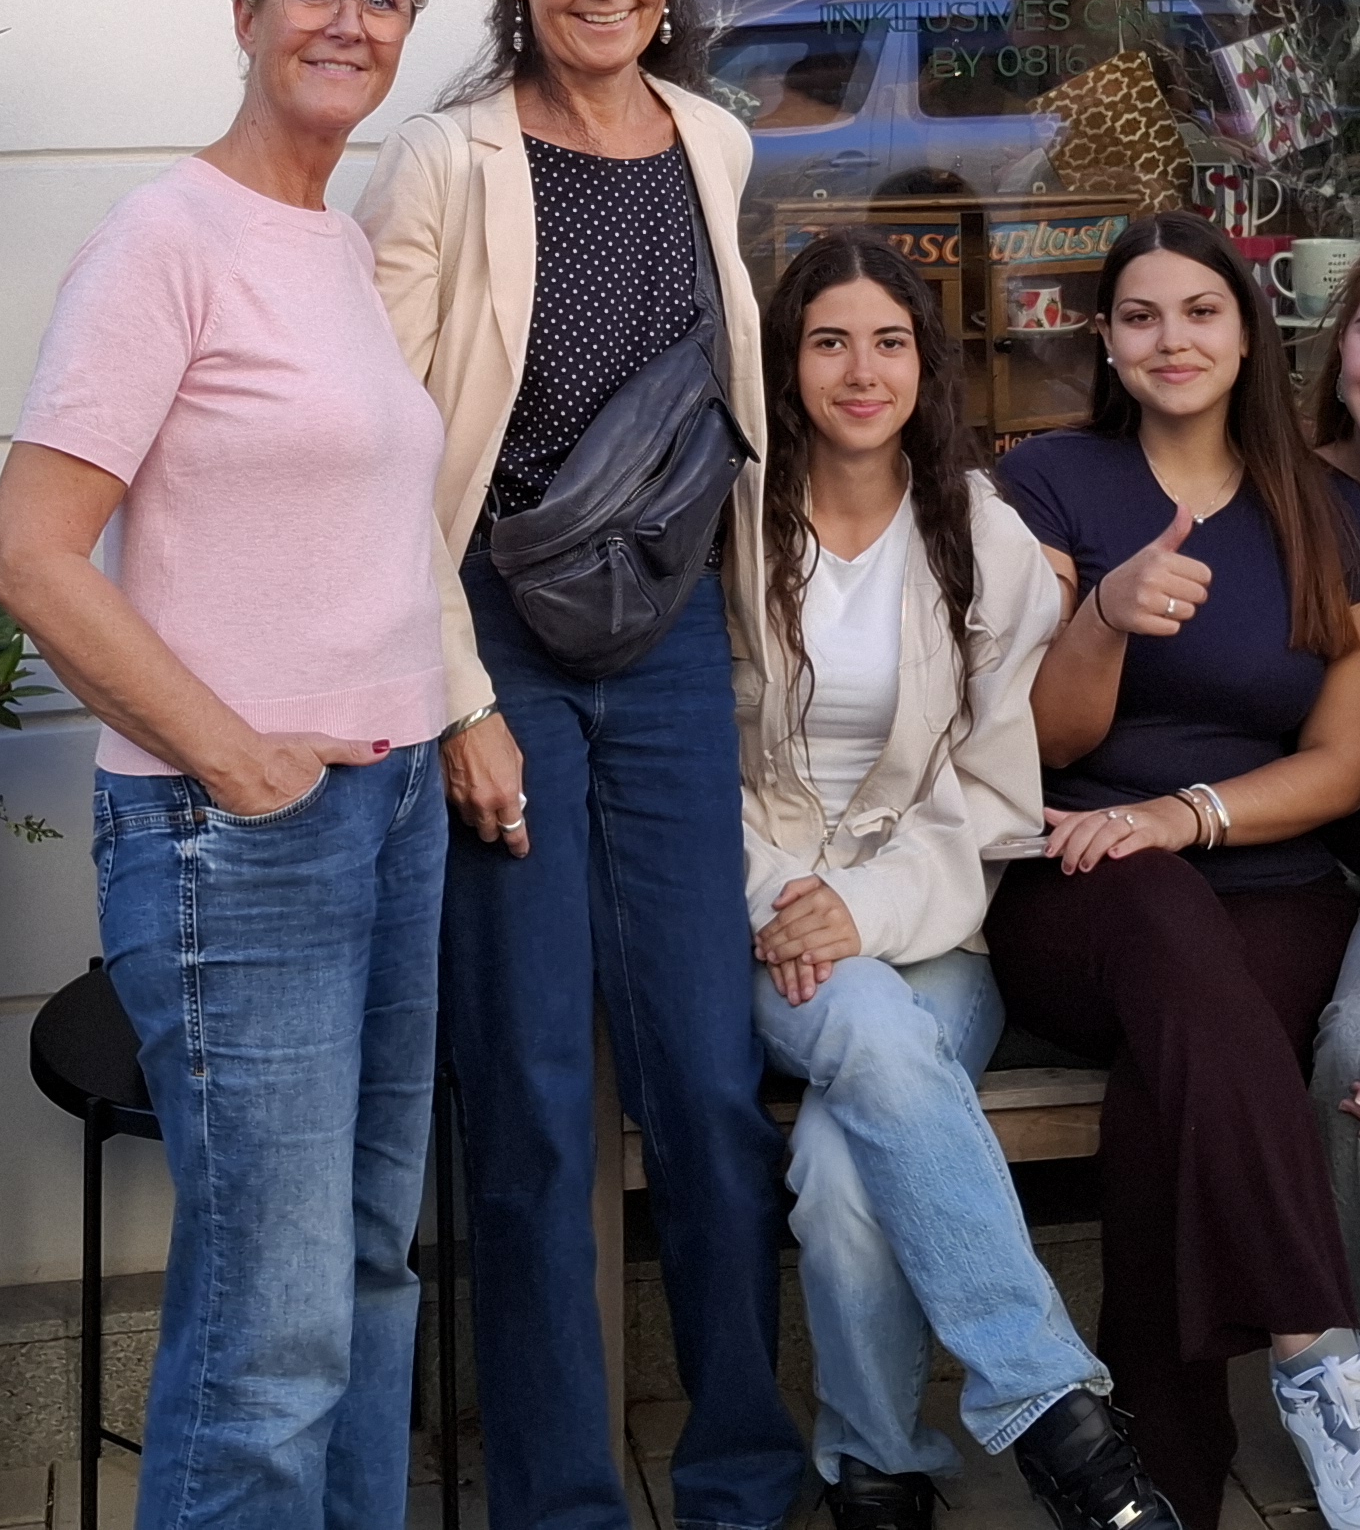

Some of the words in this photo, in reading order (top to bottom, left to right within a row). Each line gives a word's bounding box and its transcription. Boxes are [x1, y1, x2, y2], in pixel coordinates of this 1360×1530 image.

[823, 0, 1070, 33] INKLUSIVES
[933, 46, 985, 78] BY
[997, 44, 1088, 77] 0816
